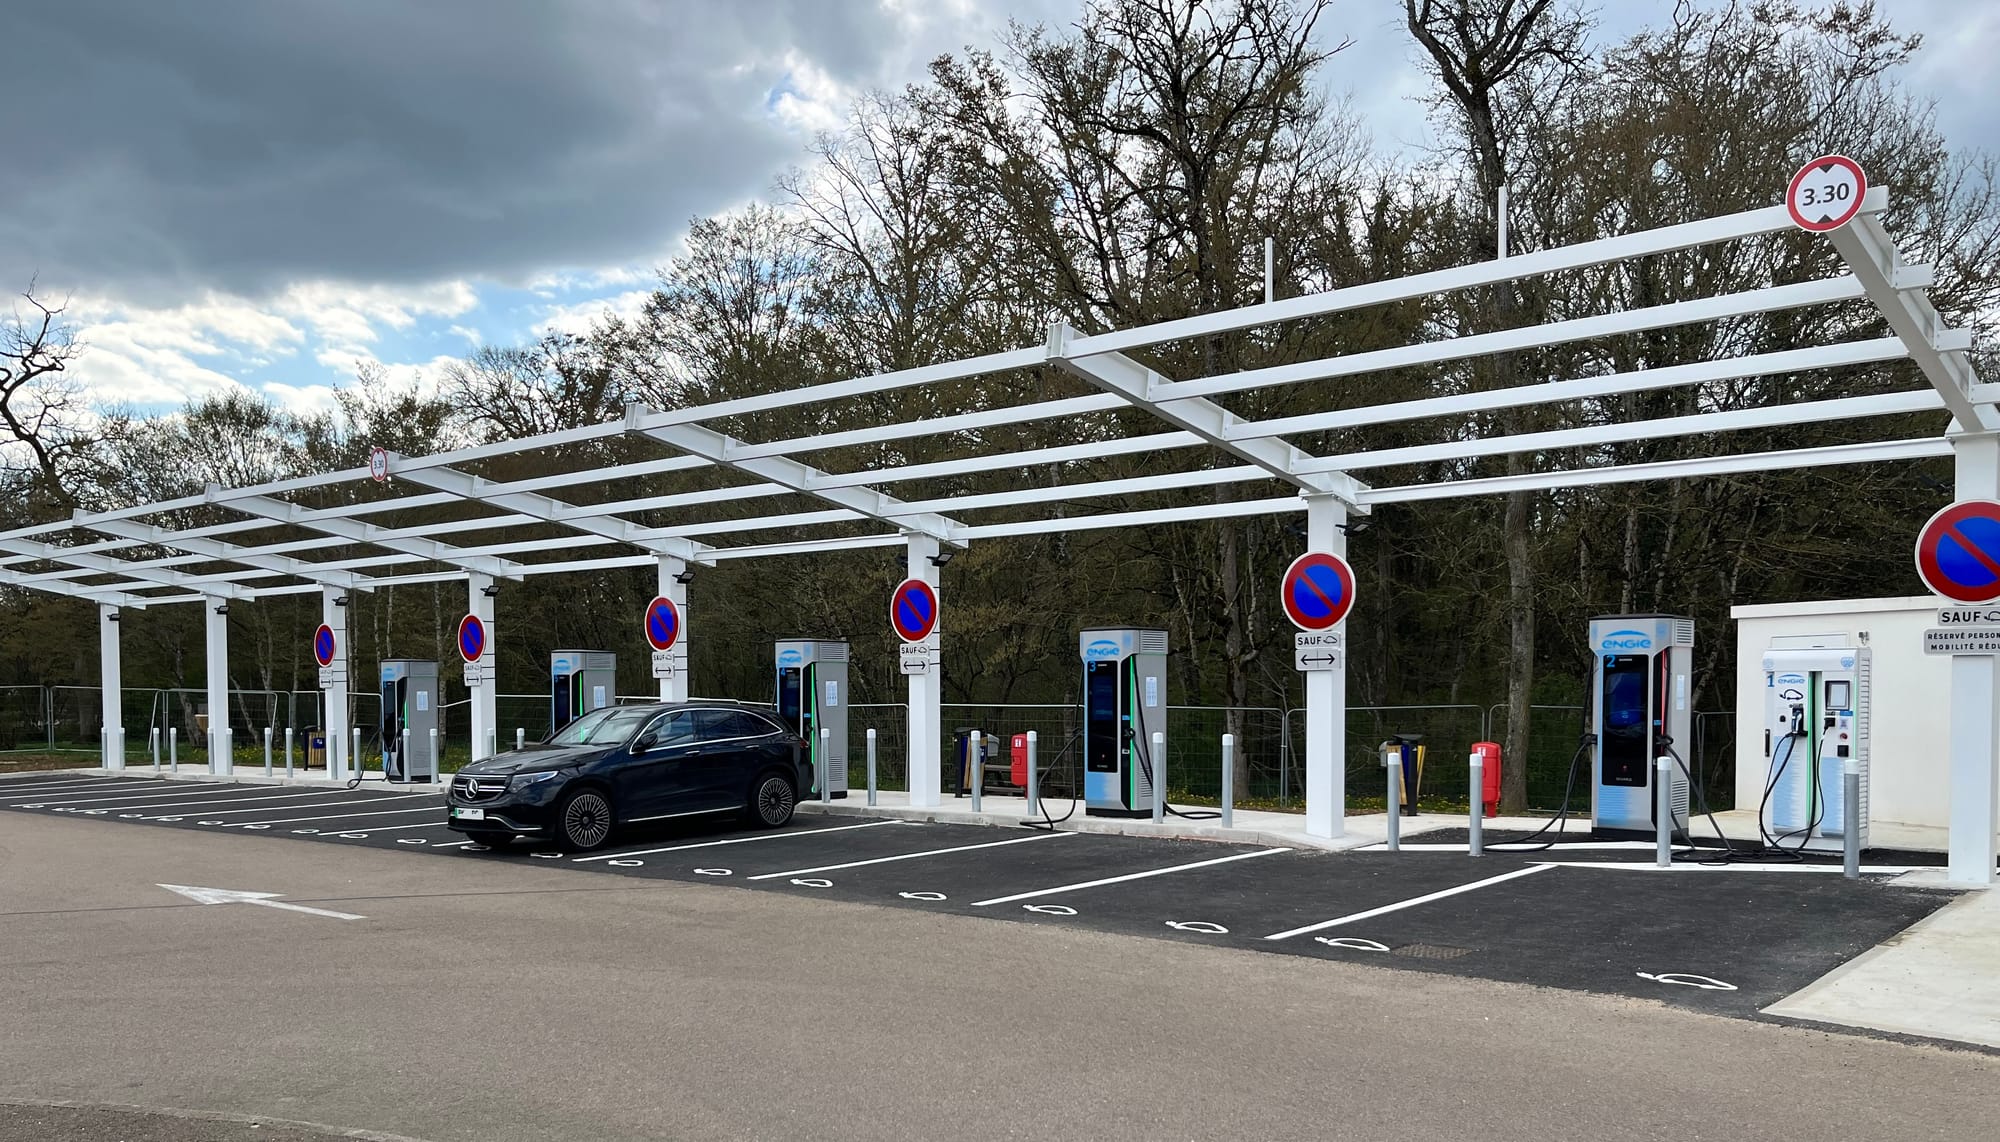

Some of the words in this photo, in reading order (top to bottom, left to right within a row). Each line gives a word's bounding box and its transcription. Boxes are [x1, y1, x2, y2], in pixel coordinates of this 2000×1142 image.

[1802, 182, 1850, 207] 3.30
[1941, 611, 1982, 623] SAUF
[1297, 636, 1322, 646] SAUF
[1927, 632, 1966, 640] RÉSERVÉ
[901, 646, 917, 654] SAUF
[1930, 642, 1975, 650] MOBILITÉ
[1089, 660, 1097, 672] 3
[1606, 655, 1616, 668] 2
[1766, 674, 1775, 687] 1
